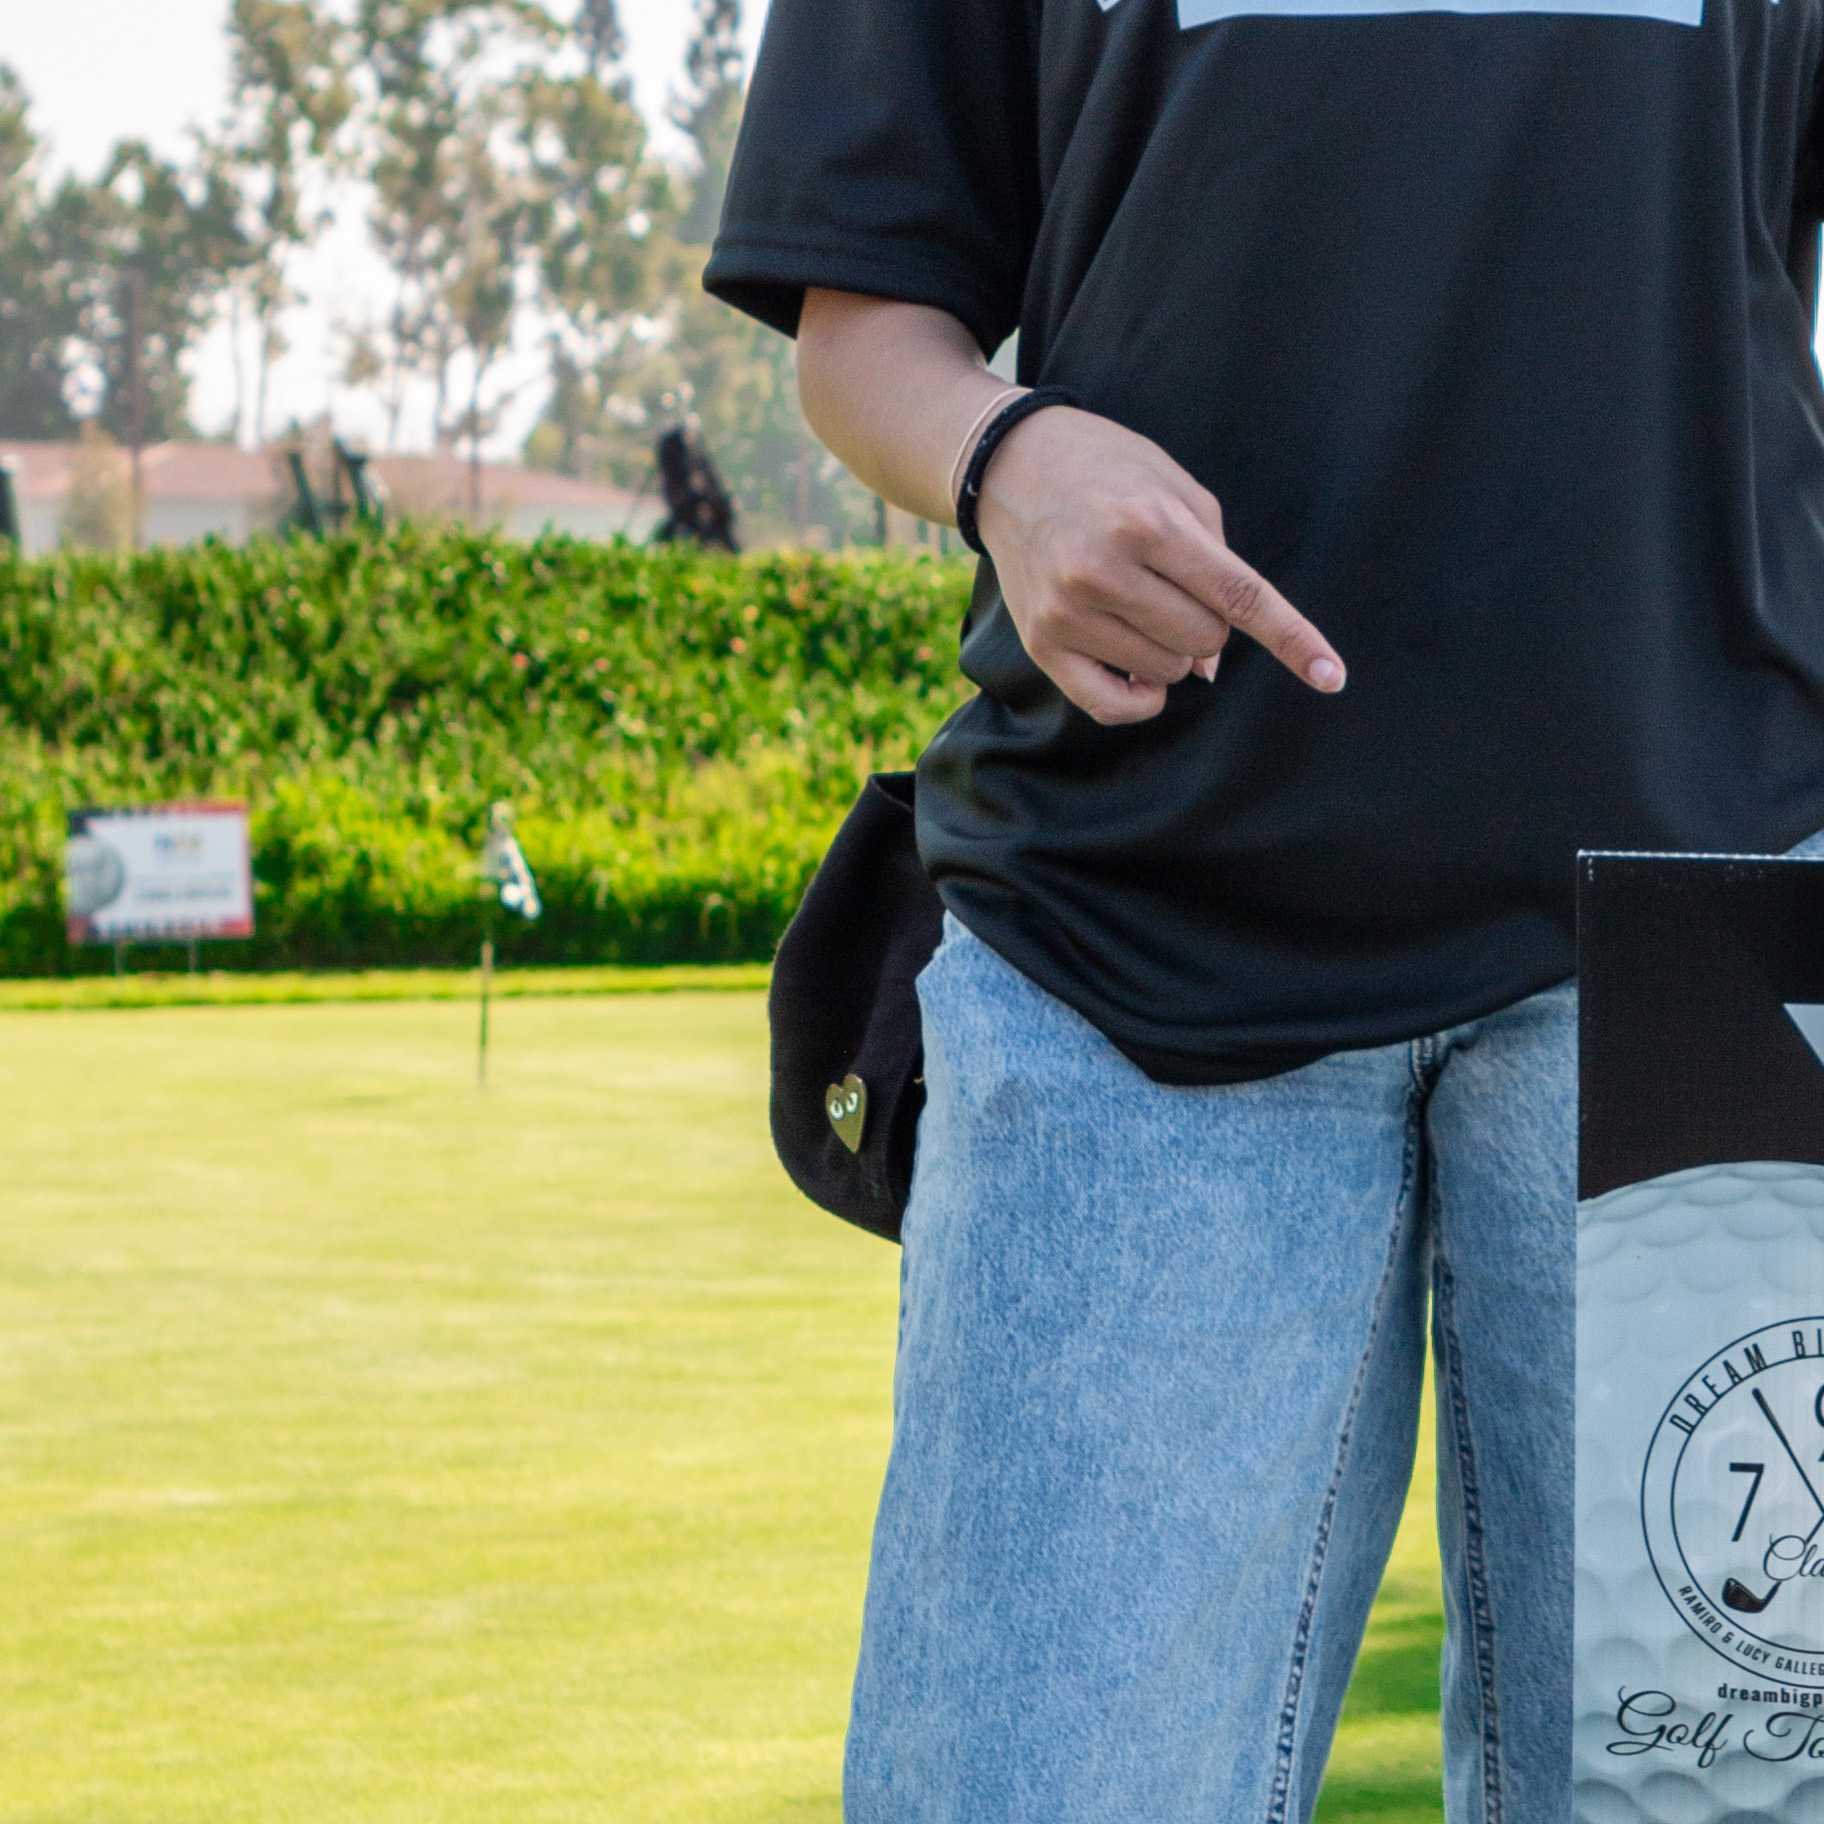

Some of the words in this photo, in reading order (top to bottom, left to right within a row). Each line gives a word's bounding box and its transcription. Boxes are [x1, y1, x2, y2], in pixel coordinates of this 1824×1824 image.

[1669, 1343, 1766, 1434] DREAM
[1729, 1462, 1765, 1542] 7
[1678, 1585, 1722, 1635] RAMIRO
[1723, 1631, 1736, 1644] &
[1736, 1639, 1772, 1664] LUCY
[1606, 1685, 1734, 1768] Golf
